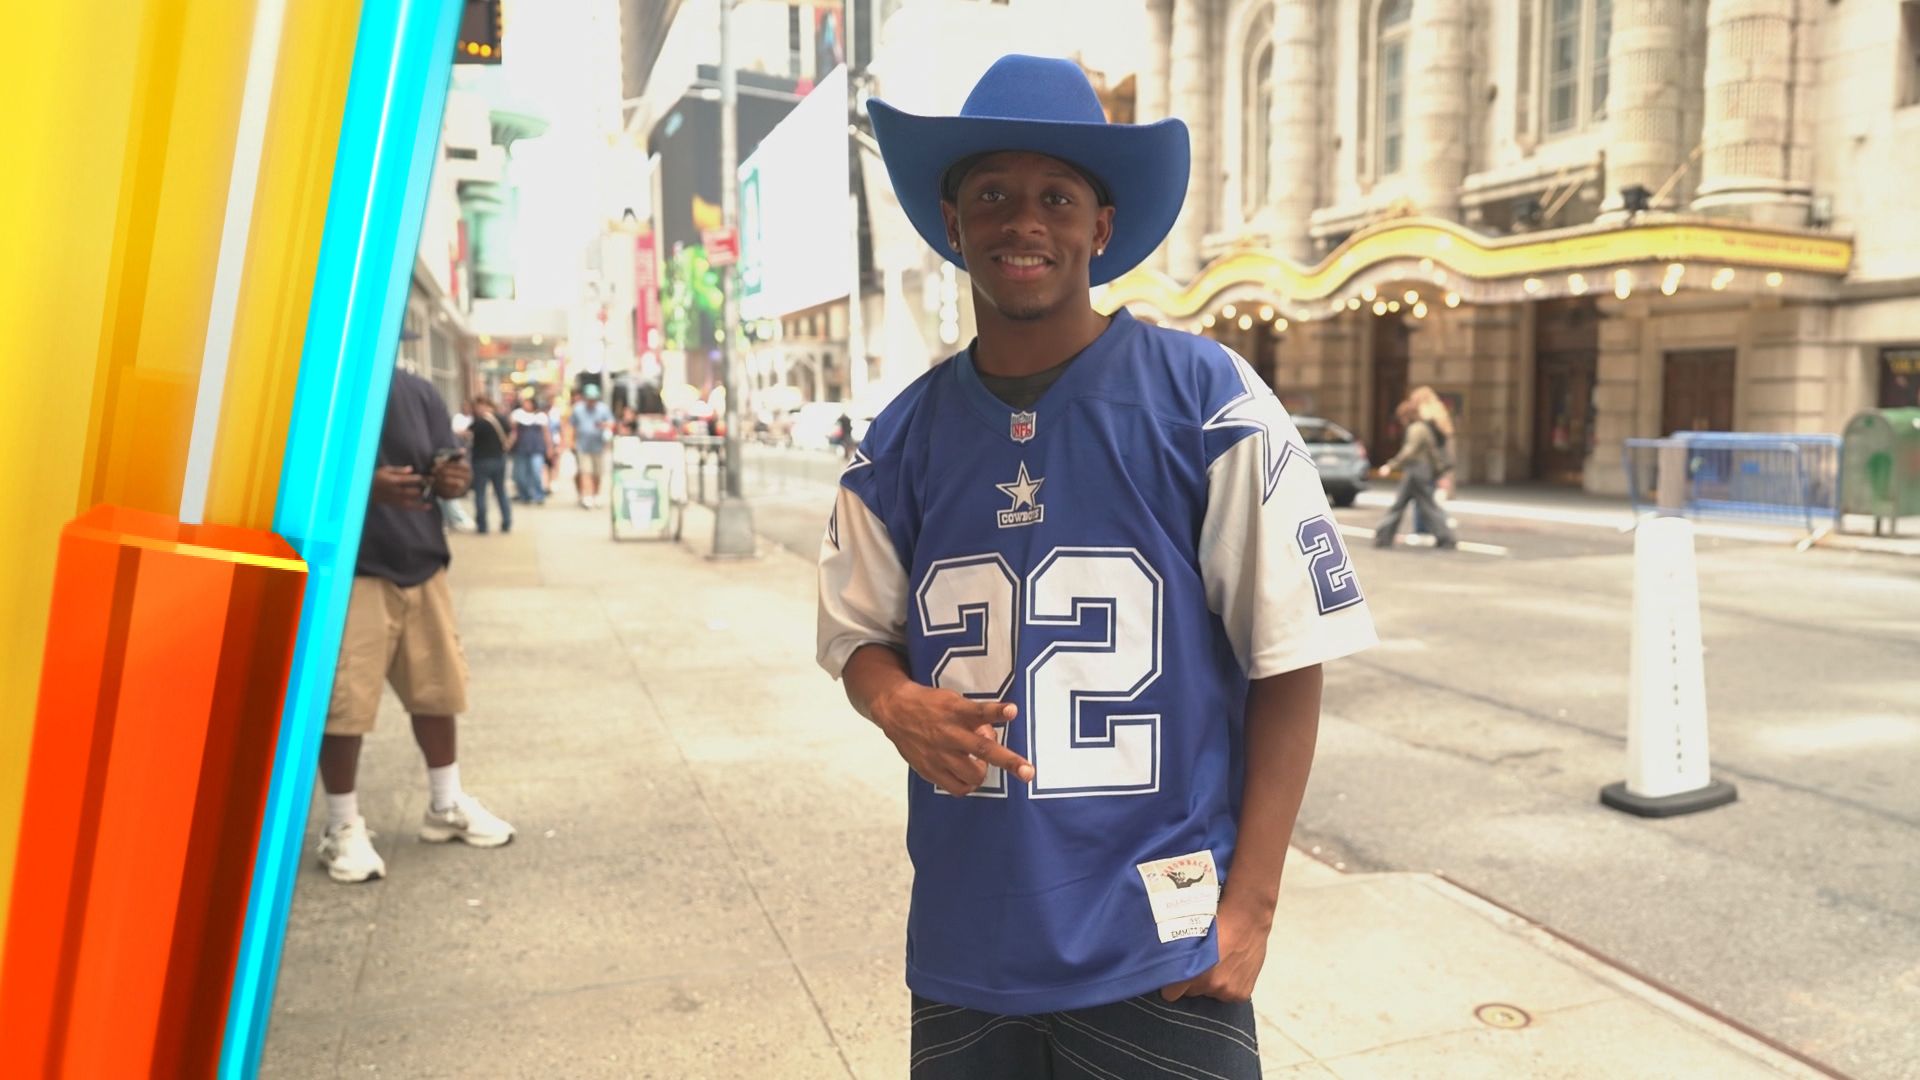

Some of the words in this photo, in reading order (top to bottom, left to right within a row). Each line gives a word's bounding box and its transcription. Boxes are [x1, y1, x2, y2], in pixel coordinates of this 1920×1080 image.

[1013, 423, 1034, 438] NFL
[1296, 514, 1364, 616] 2
[916, 546, 1164, 799] 22
